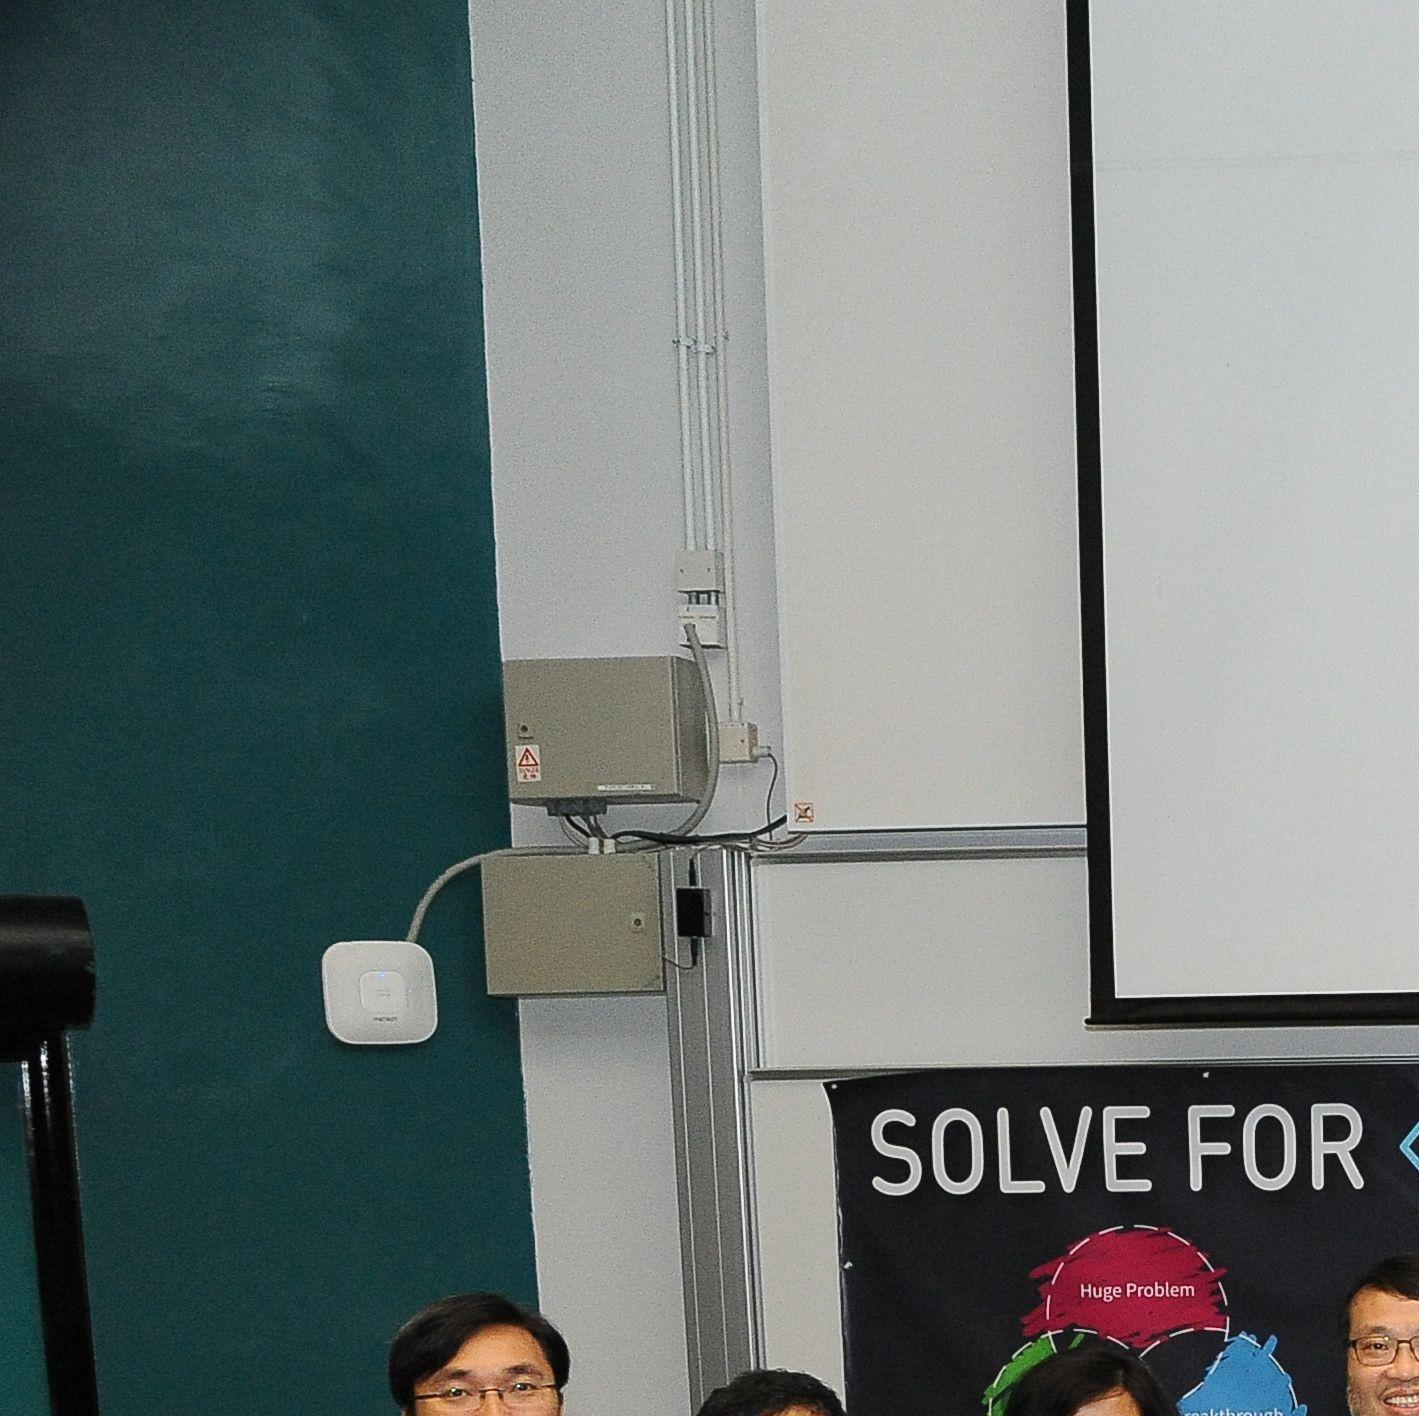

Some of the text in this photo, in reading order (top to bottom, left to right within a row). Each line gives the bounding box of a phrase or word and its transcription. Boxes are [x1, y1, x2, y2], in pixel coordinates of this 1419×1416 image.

[870, 1105, 1153, 1196] SOLVE
[1186, 1102, 1365, 1193] FOR
[1080, 1281, 1195, 1303] Huge Problem
